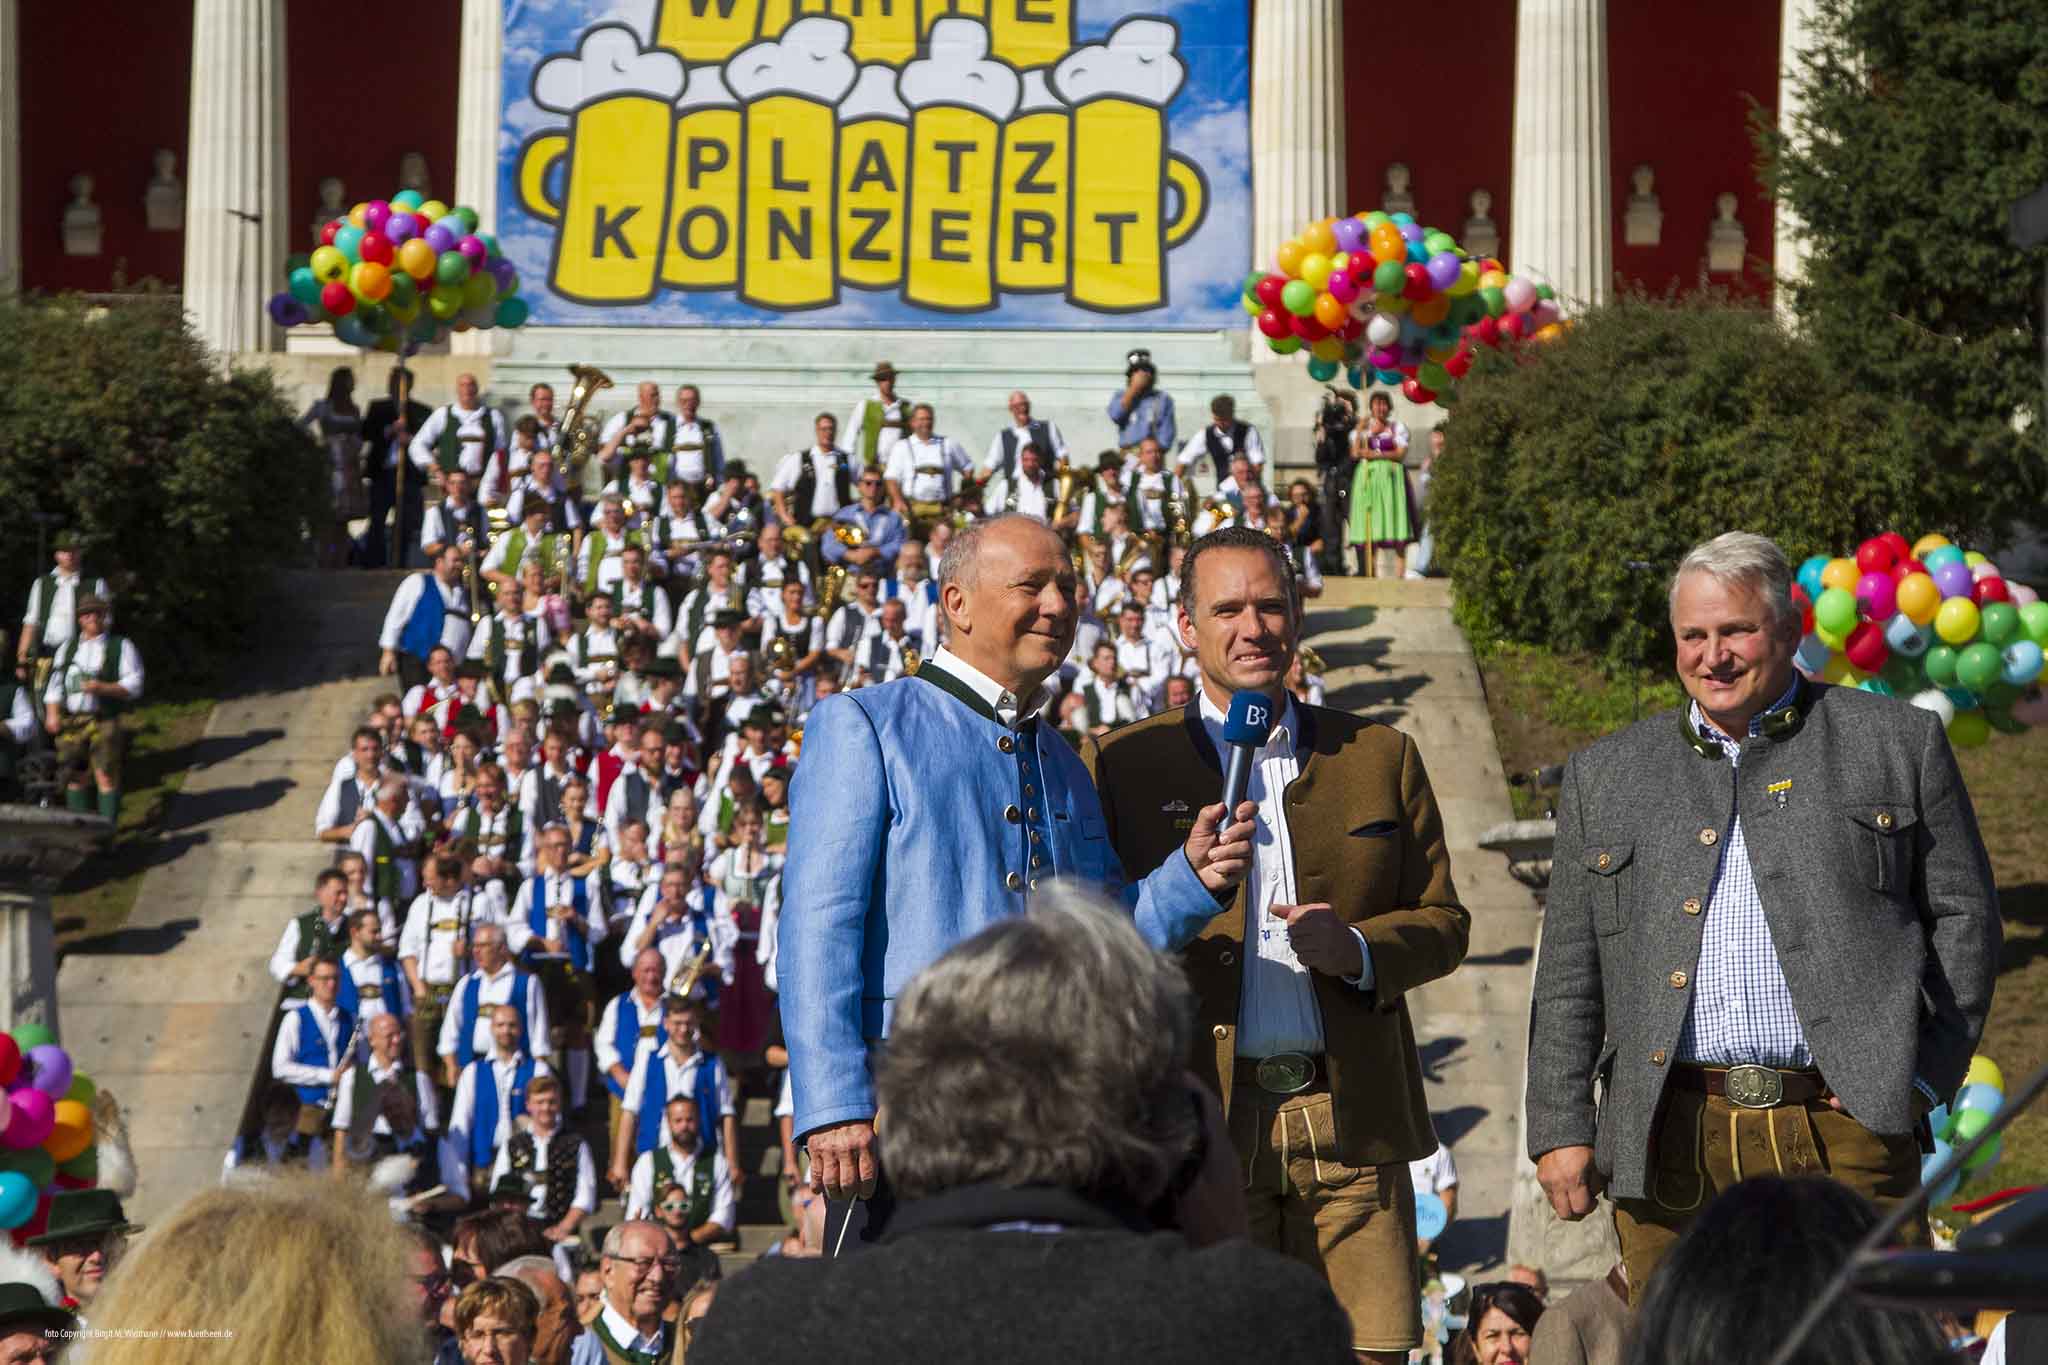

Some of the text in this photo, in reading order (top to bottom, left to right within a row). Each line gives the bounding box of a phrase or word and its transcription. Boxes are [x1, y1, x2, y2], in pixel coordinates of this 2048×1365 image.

[688, 138, 1056, 194] PLATZ
[593, 206, 1137, 265] KONZERT
[1245, 704, 1269, 729] BR
